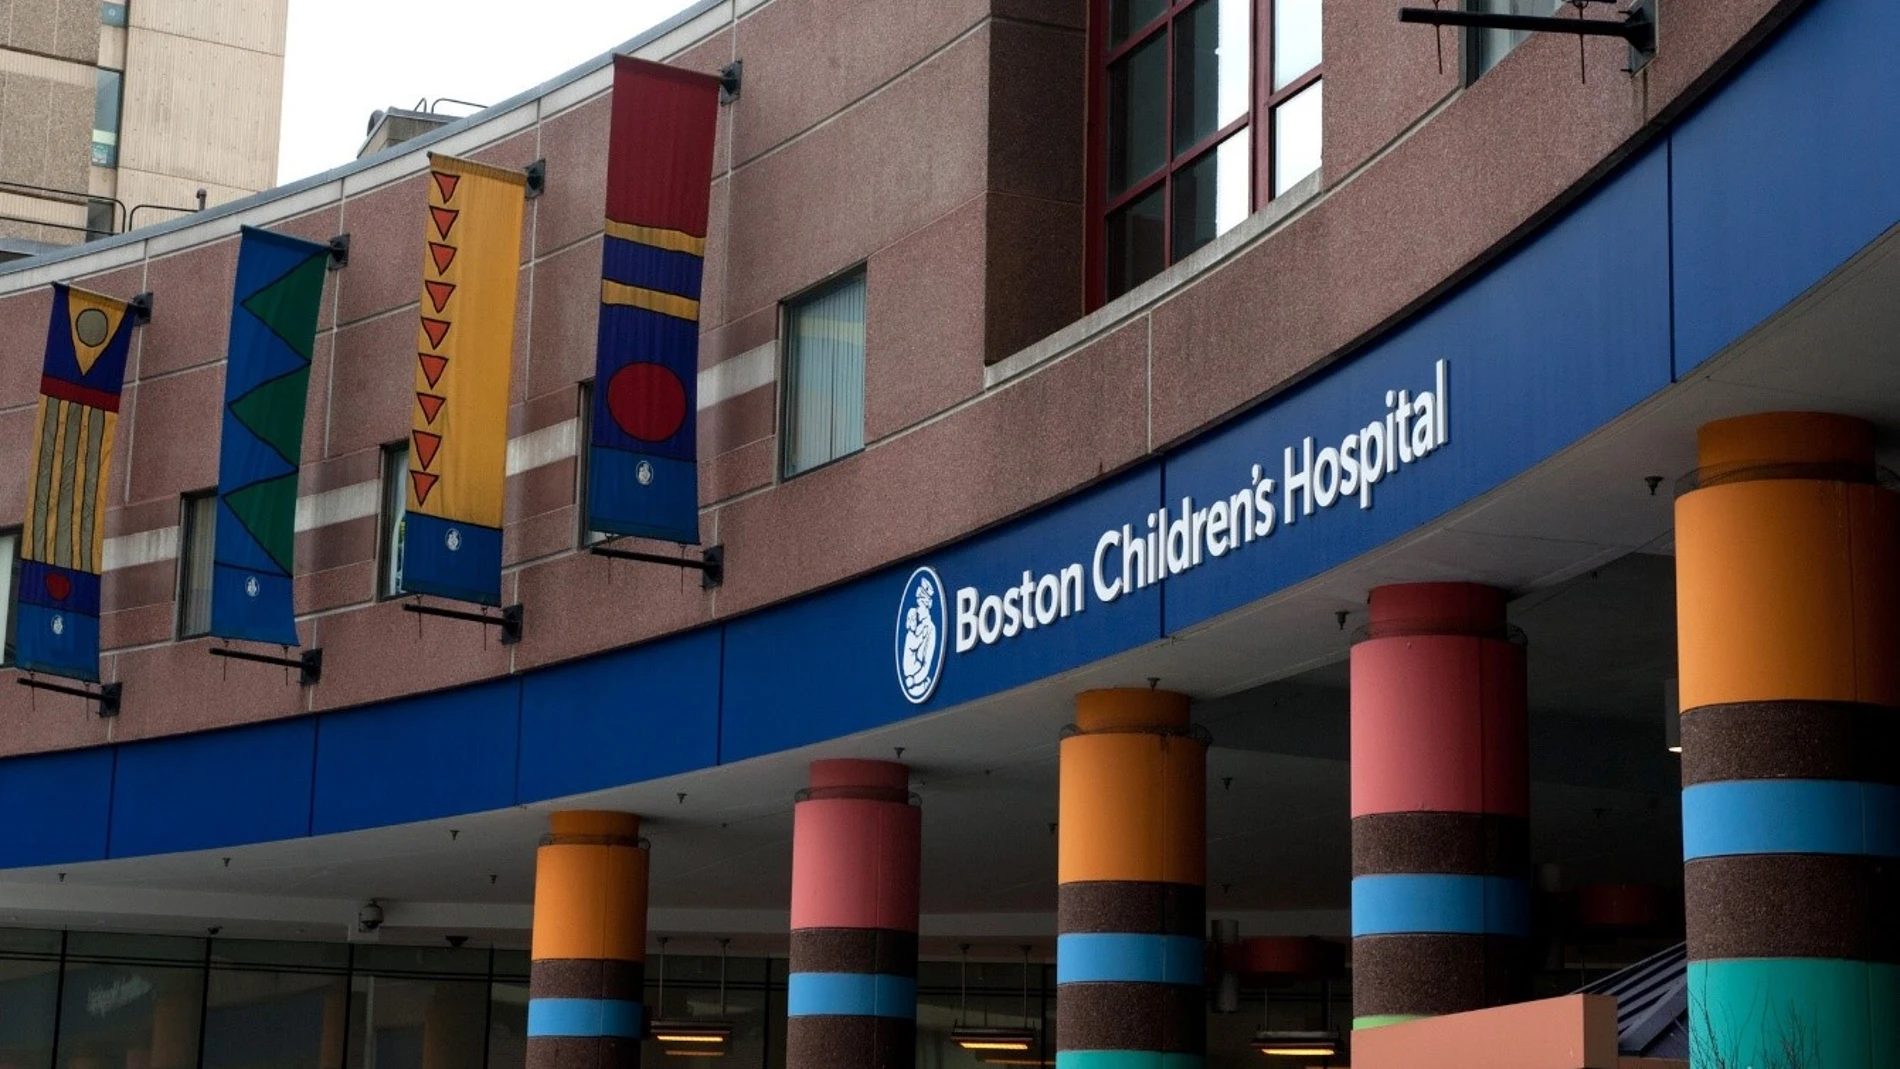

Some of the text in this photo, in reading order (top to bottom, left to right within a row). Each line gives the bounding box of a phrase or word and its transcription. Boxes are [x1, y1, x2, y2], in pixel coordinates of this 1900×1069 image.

[956, 359, 1450, 654] Boston Children's Hospital
